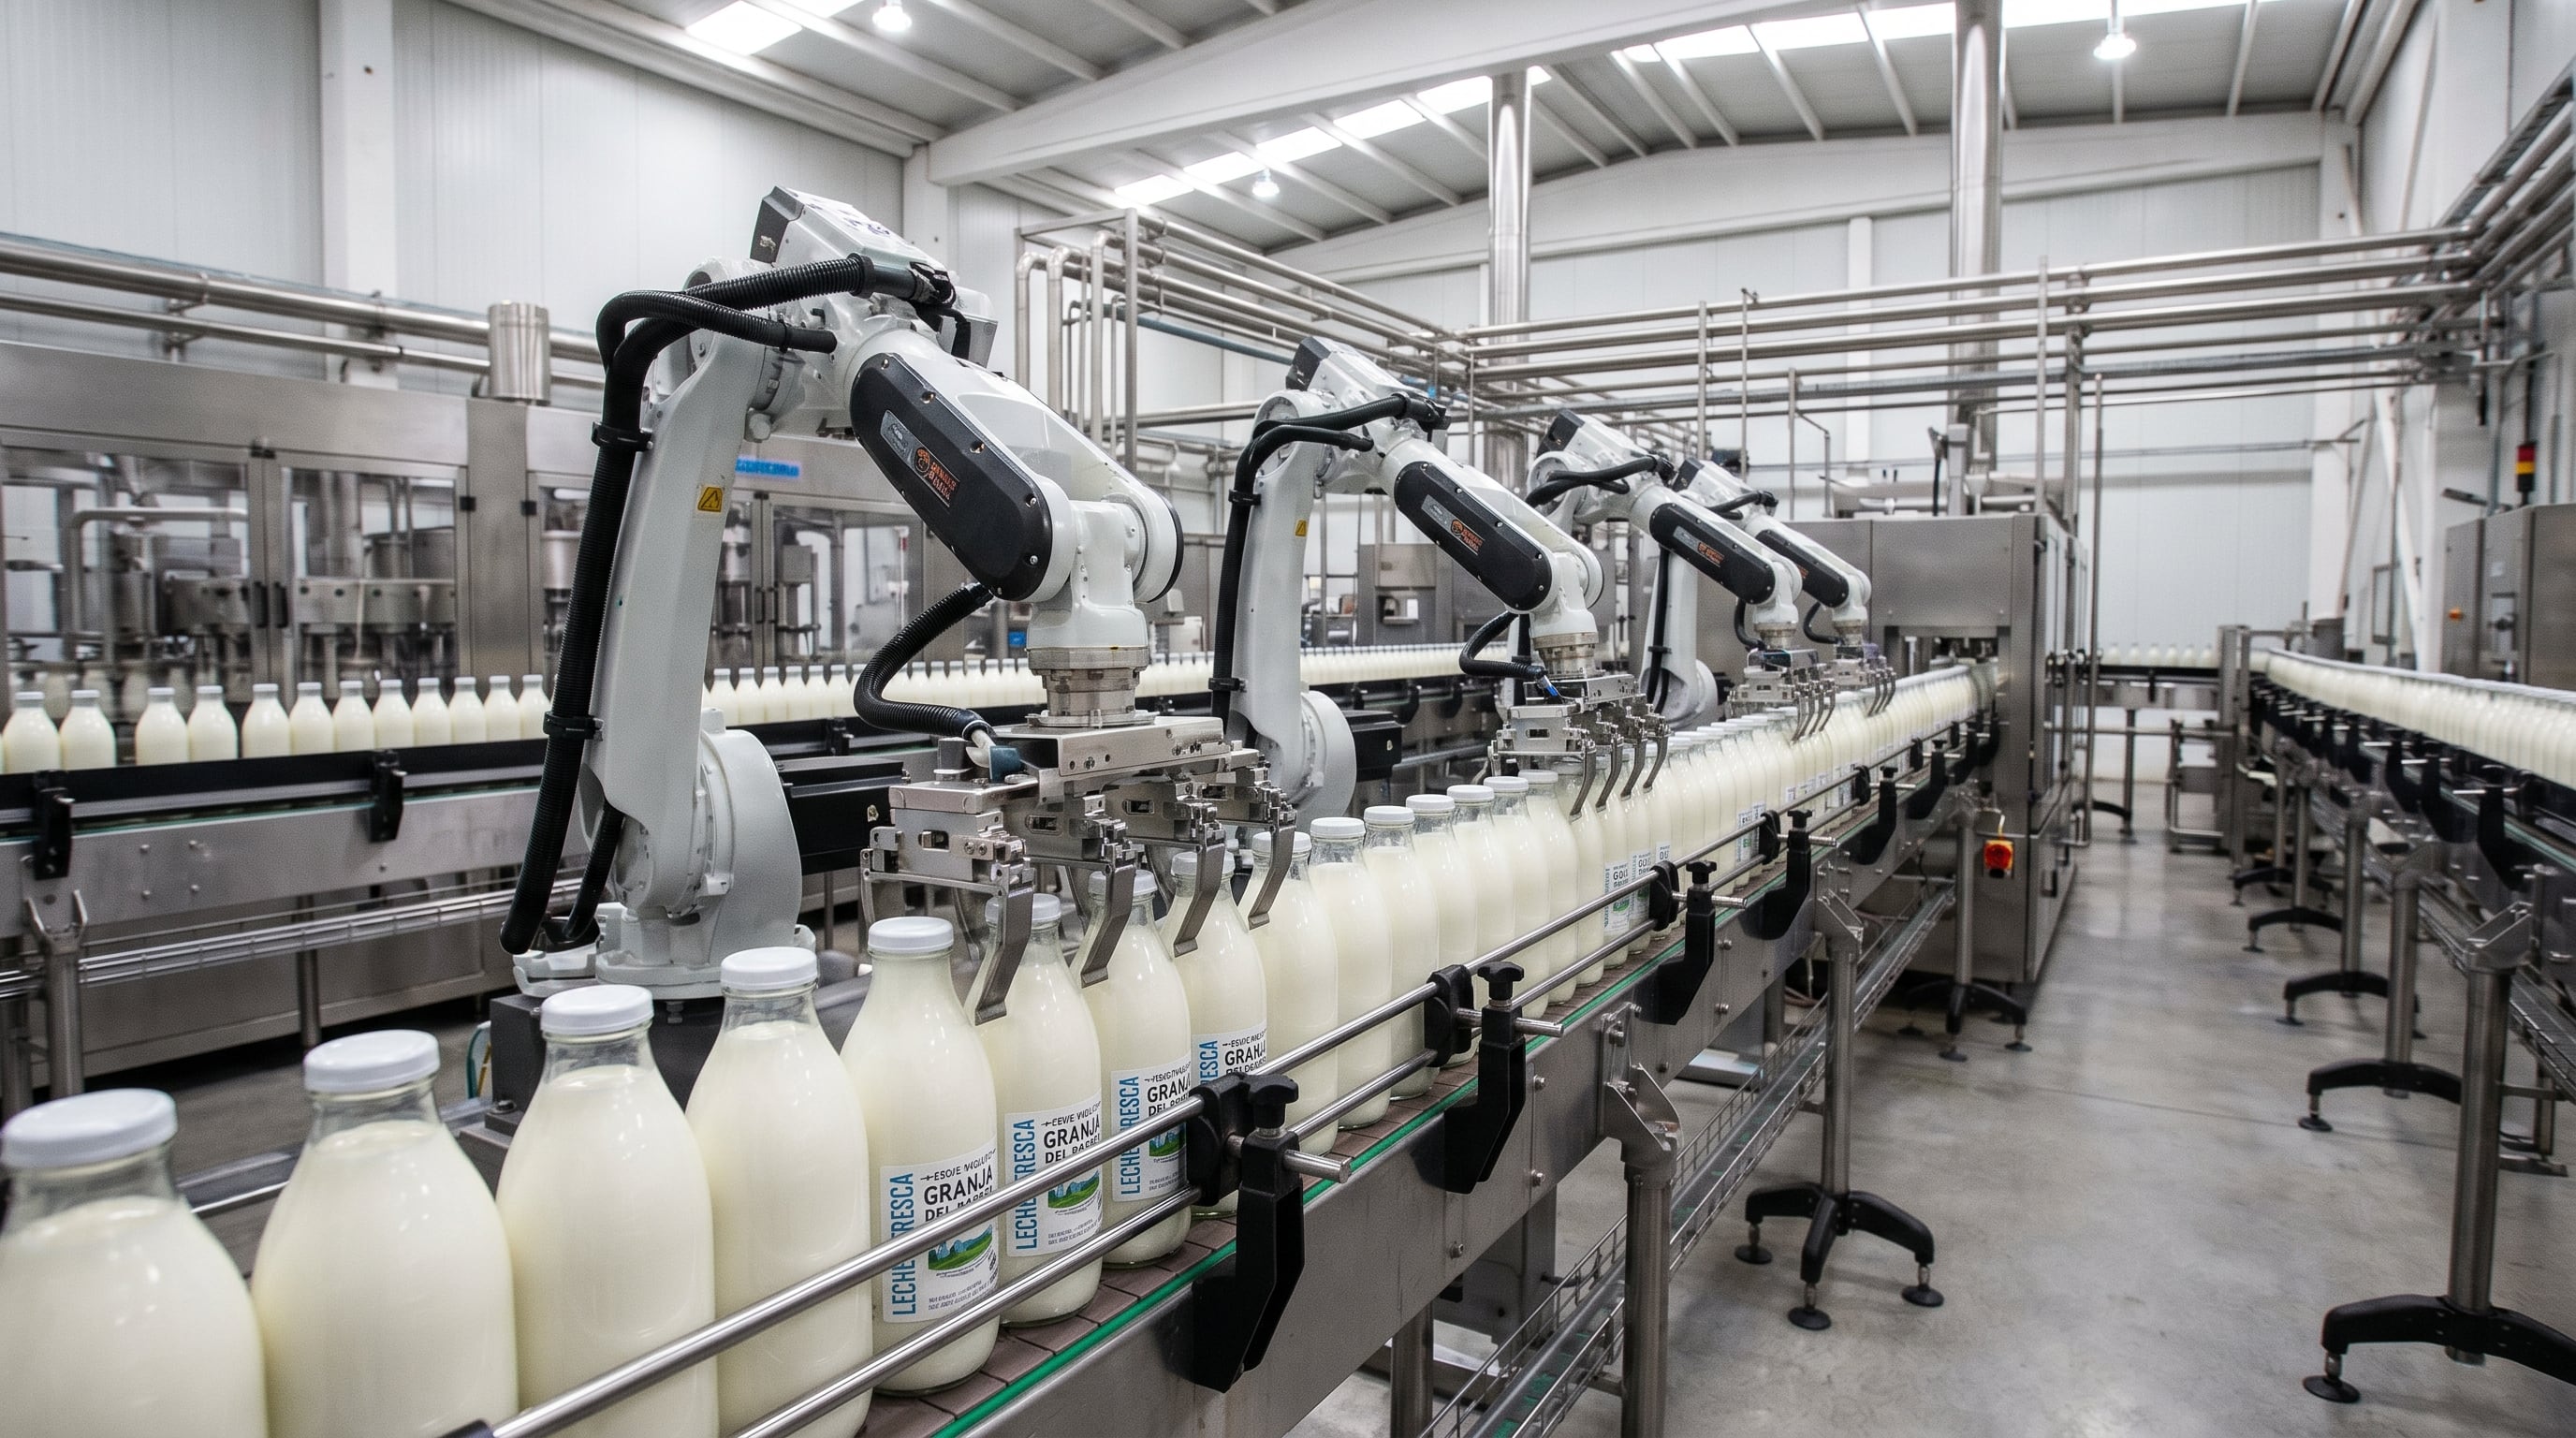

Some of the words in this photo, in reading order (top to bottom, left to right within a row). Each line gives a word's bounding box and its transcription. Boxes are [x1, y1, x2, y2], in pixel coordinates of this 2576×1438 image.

[1199, 1040, 1219, 1085] ESCA
[1119, 1076, 1140, 1131] RESCA
[1044, 1114, 1100, 1149] GRANJA
[924, 1165, 992, 1206] GRANJA
[1120, 1147, 1141, 1195] LECHE
